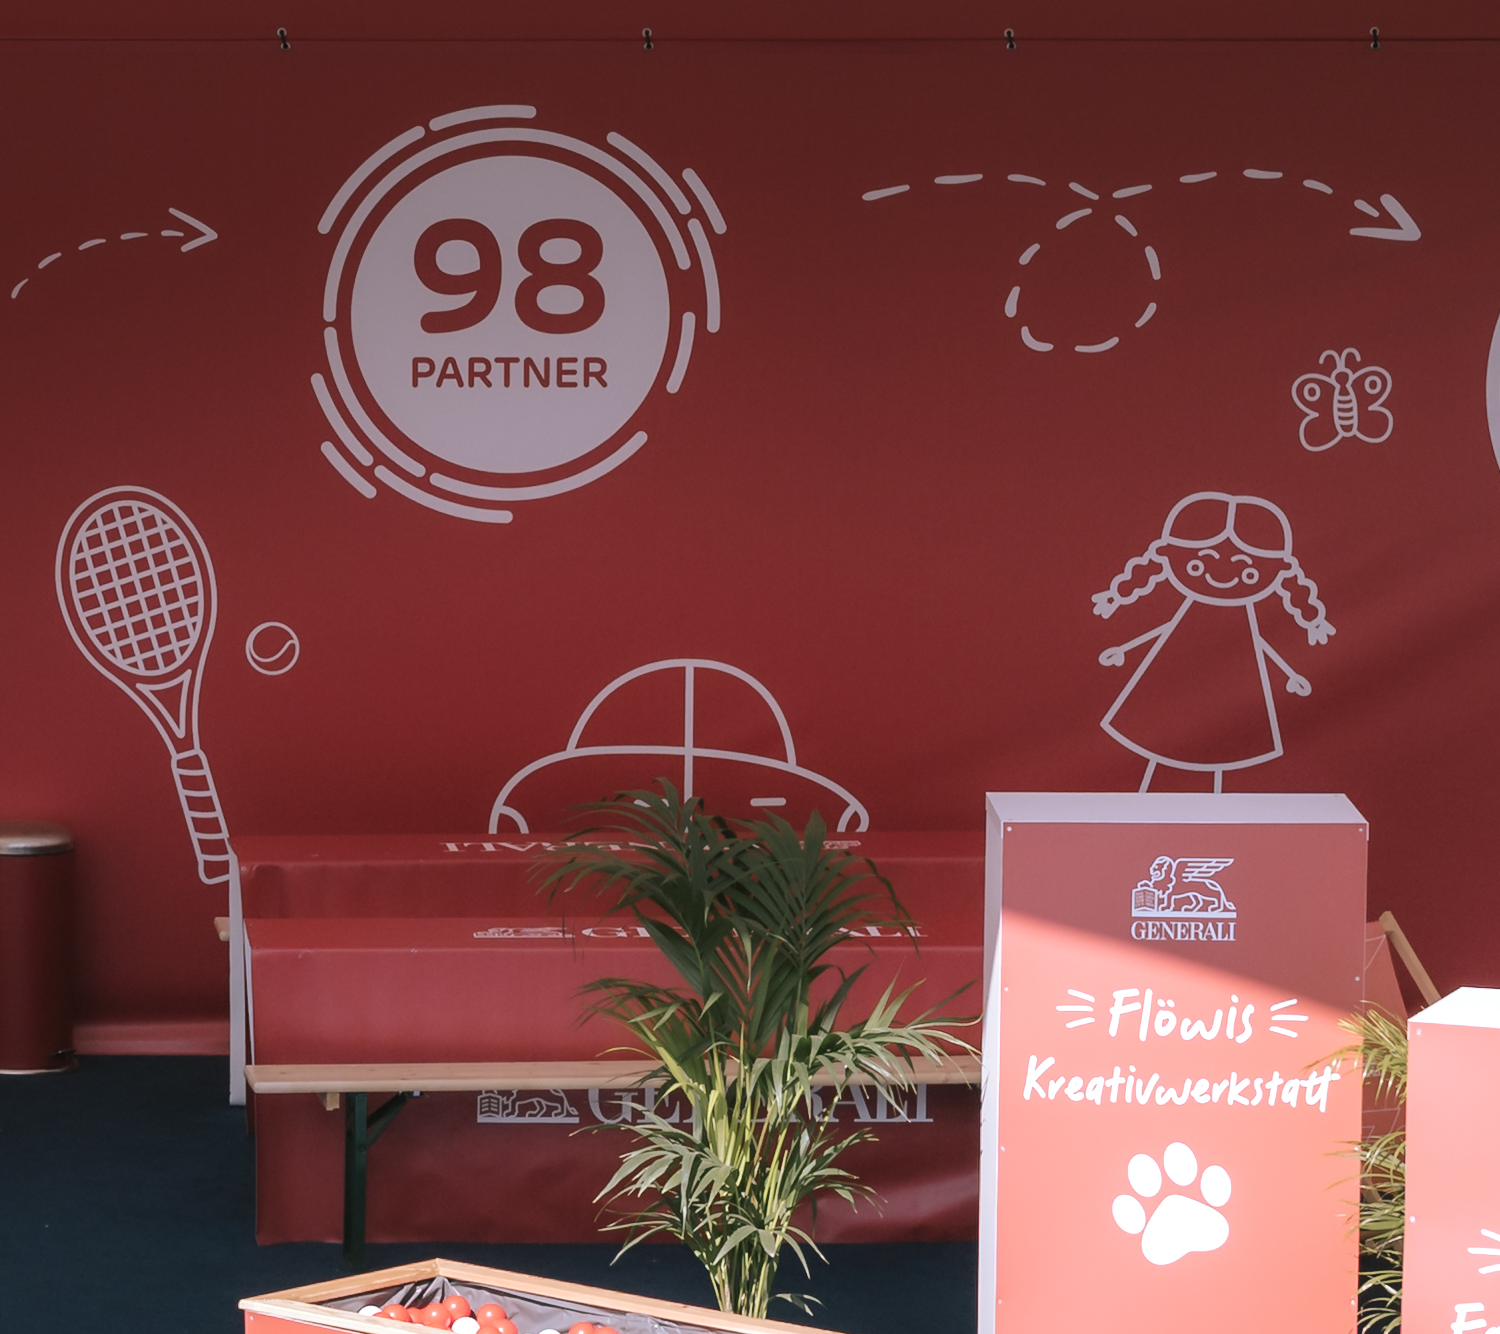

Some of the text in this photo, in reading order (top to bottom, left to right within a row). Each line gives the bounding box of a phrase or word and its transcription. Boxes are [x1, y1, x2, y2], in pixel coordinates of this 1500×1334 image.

[413, 217, 606, 335] 98
[411, 356, 609, 389] PARTNER
[1130, 920, 1237, 942] GENERALI
[1108, 987, 1255, 1044] Flöwis
[1022, 1054, 1342, 1113] Kreativwerkstatt
